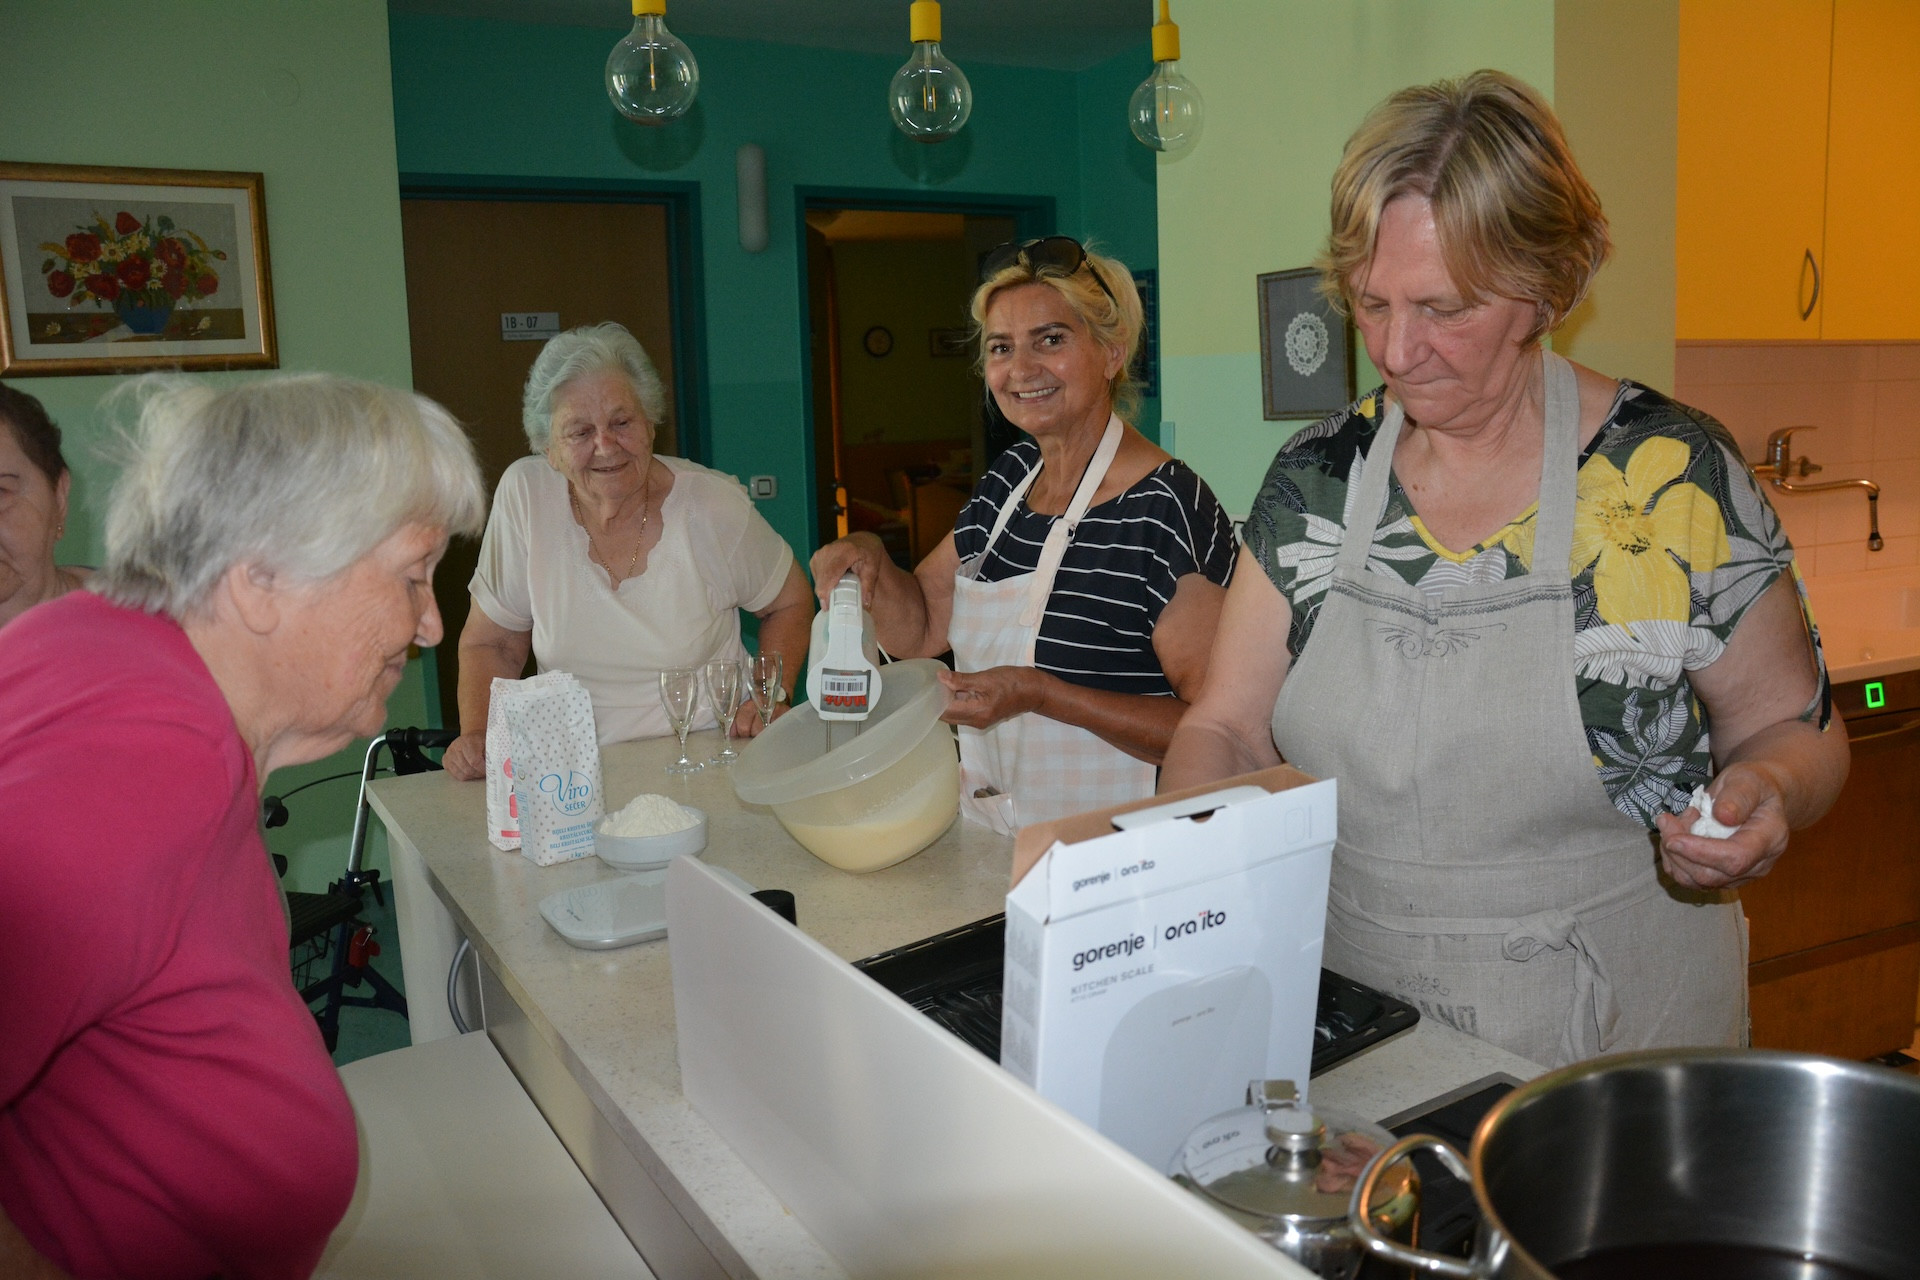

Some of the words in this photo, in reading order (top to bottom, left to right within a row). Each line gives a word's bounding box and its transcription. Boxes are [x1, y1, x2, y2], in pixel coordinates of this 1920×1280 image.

[526, 316, 538, 329] 07
[539, 769, 589, 802] Viro
[1072, 872, 1111, 892] gorenje
[1073, 934, 1145, 971] gorenje
[1070, 975, 1118, 995] KITCHEN
[1120, 963, 1155, 983] SCALE
